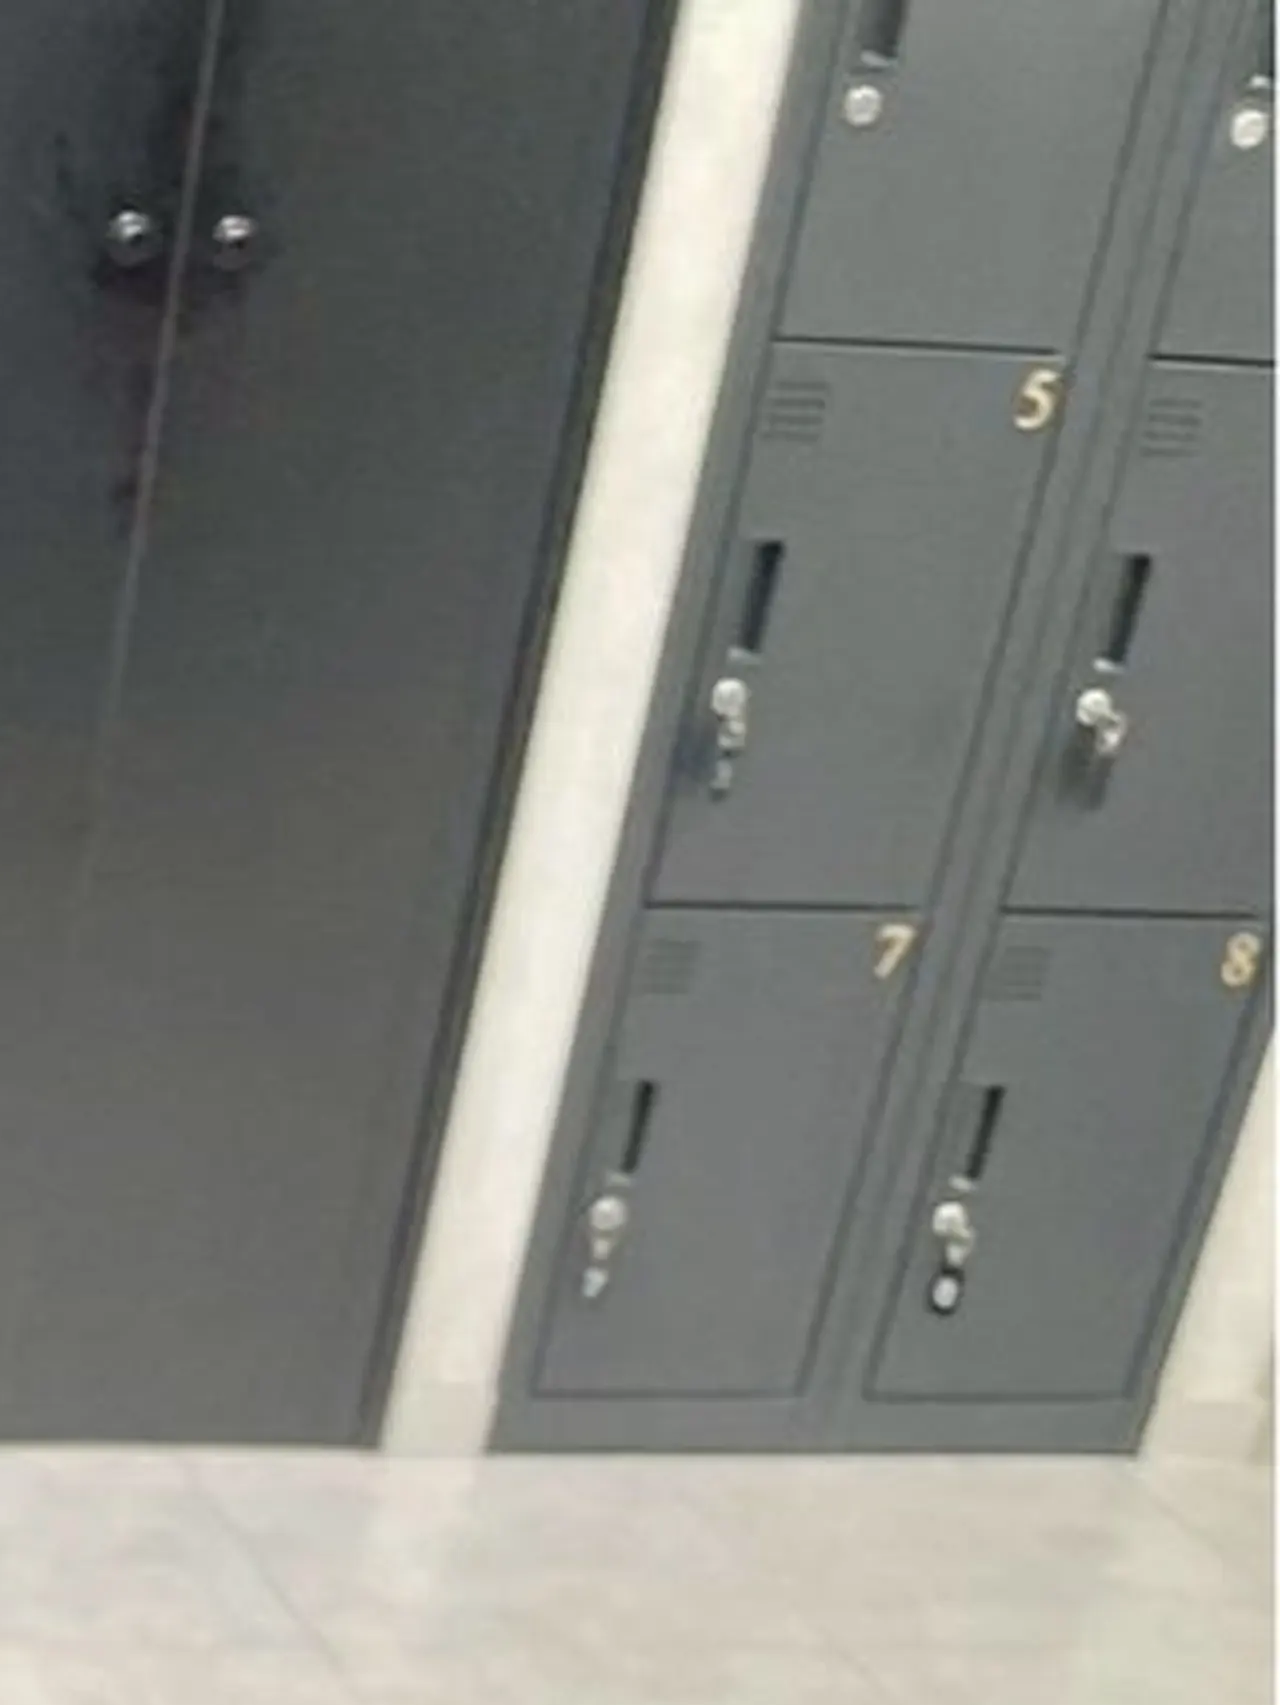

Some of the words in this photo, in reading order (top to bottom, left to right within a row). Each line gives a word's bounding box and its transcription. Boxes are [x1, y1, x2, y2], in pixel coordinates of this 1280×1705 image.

[1013, 367, 1059, 430] 5
[874, 923, 916, 979] 7
[1220, 931, 1260, 987] 8
